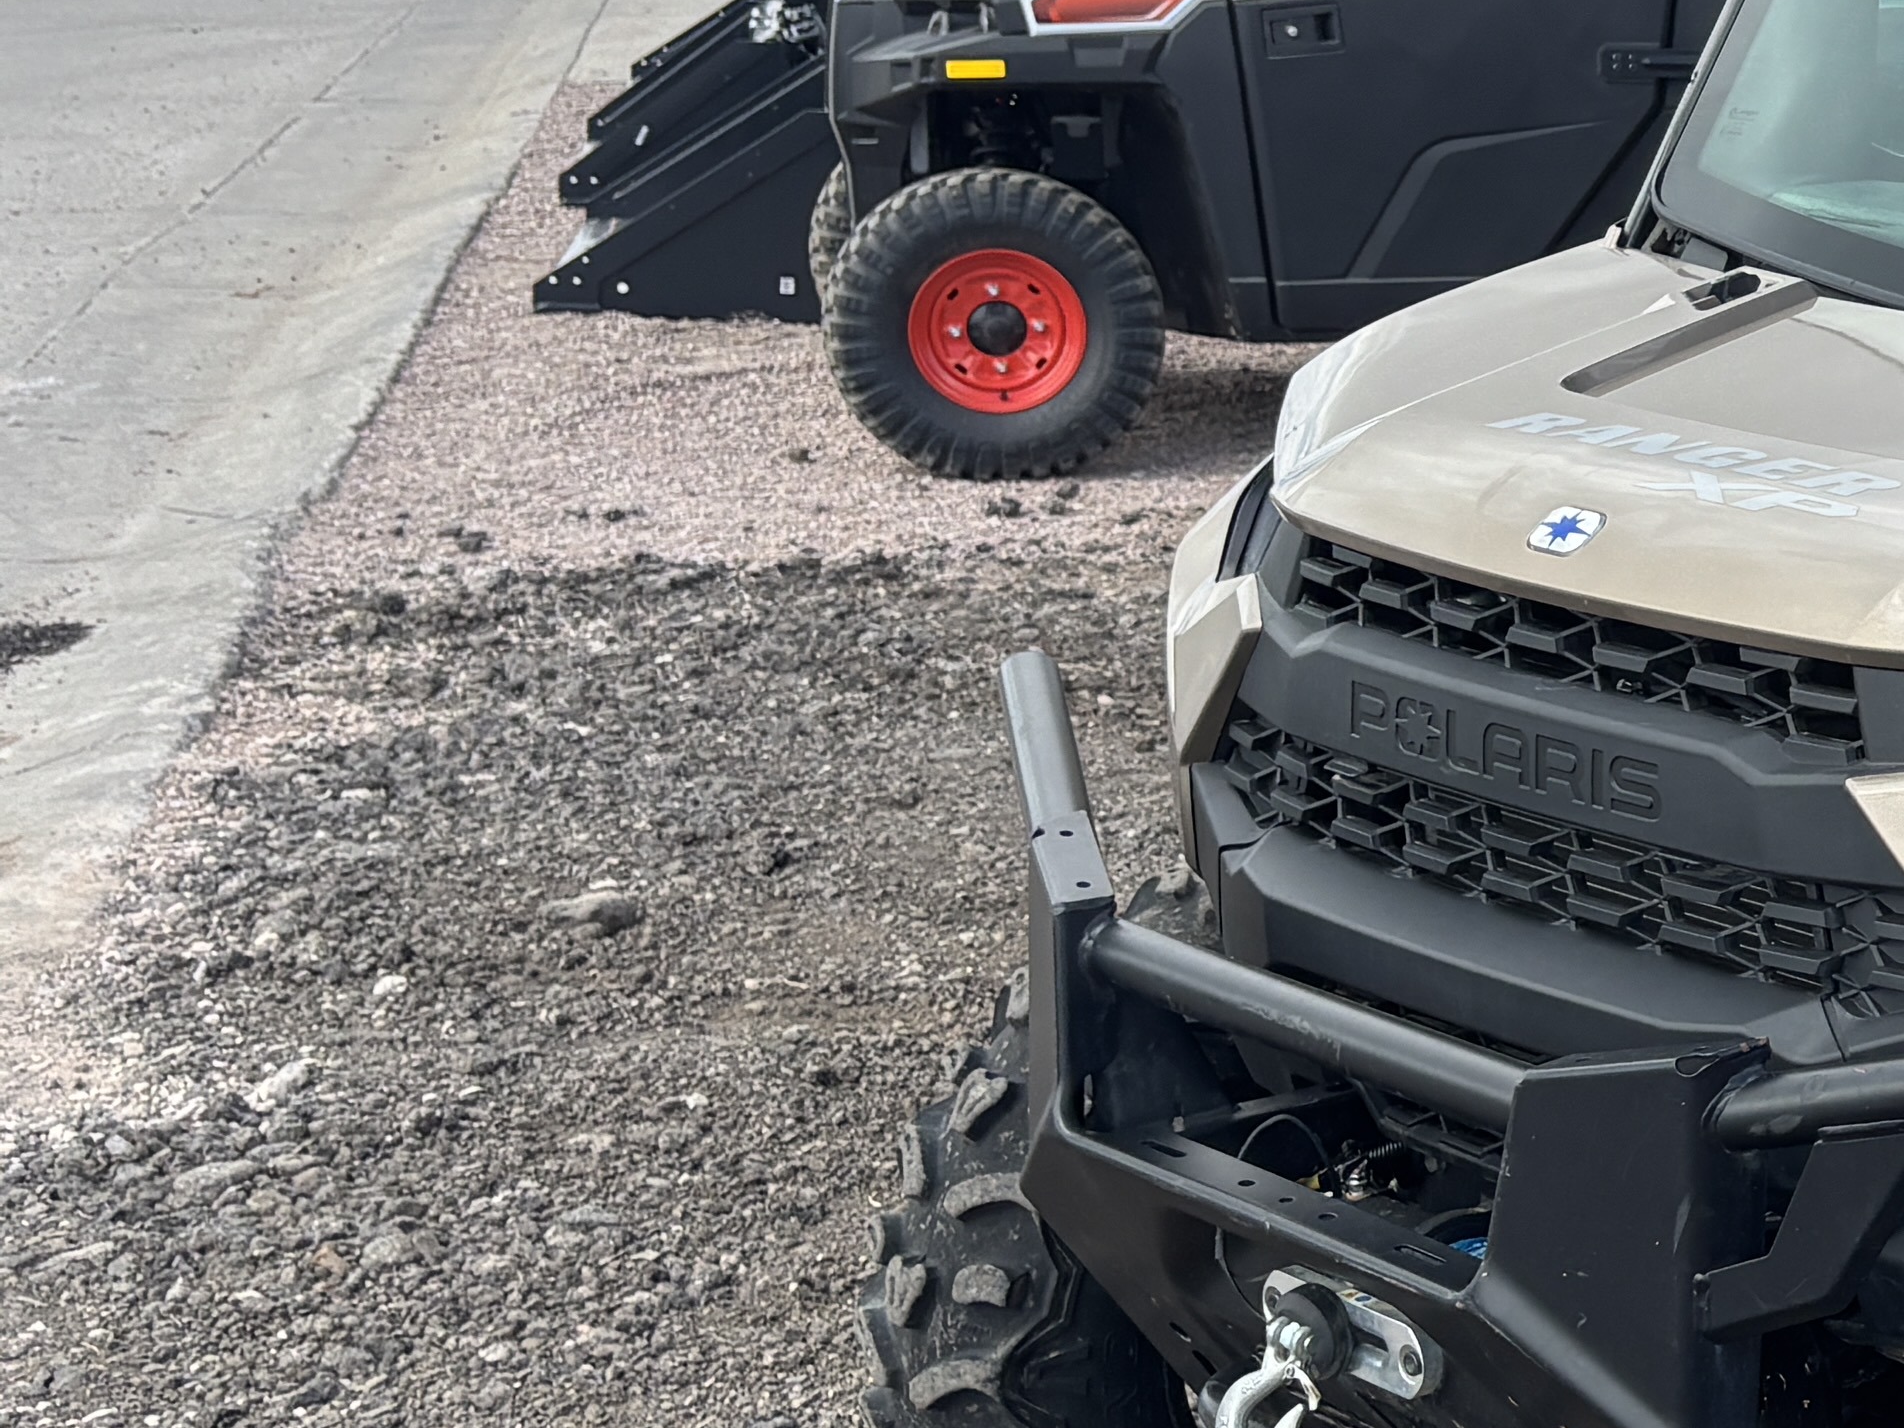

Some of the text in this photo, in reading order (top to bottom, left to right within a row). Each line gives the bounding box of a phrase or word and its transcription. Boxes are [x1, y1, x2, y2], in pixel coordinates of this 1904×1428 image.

[1485, 412, 1901, 497] RANGER
[1633, 471, 1860, 517] XP
[1350, 680, 1663, 823] POLARIS
